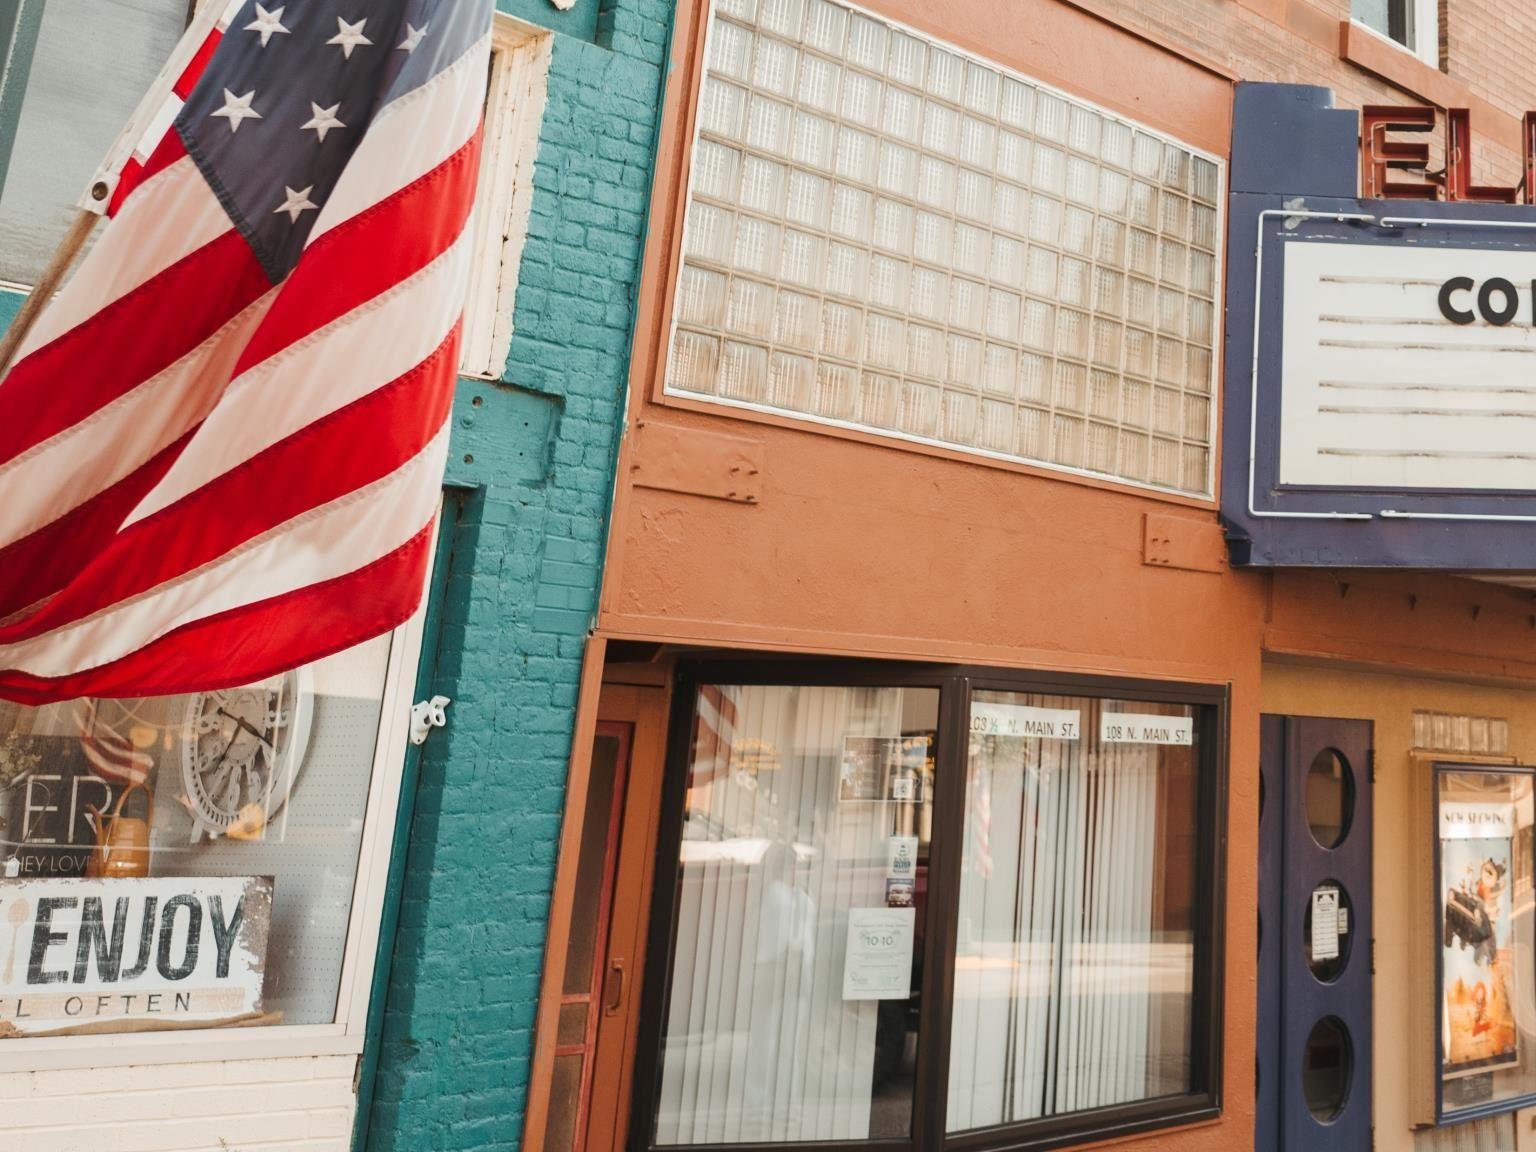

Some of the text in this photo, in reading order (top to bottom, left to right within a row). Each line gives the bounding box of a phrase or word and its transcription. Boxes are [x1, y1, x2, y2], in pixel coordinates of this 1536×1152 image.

[970, 716, 987, 731] 08
[1024, 720, 1054, 736] MAIN
[1061, 723, 1076, 737] ST.
[1106, 726, 1121, 739] 108
[1142, 728, 1169, 741] MAIN
[1175, 729, 1188, 743] ST.
[27, 894, 244, 985] ENJOY
[64, 992, 191, 1016] OFTEN
